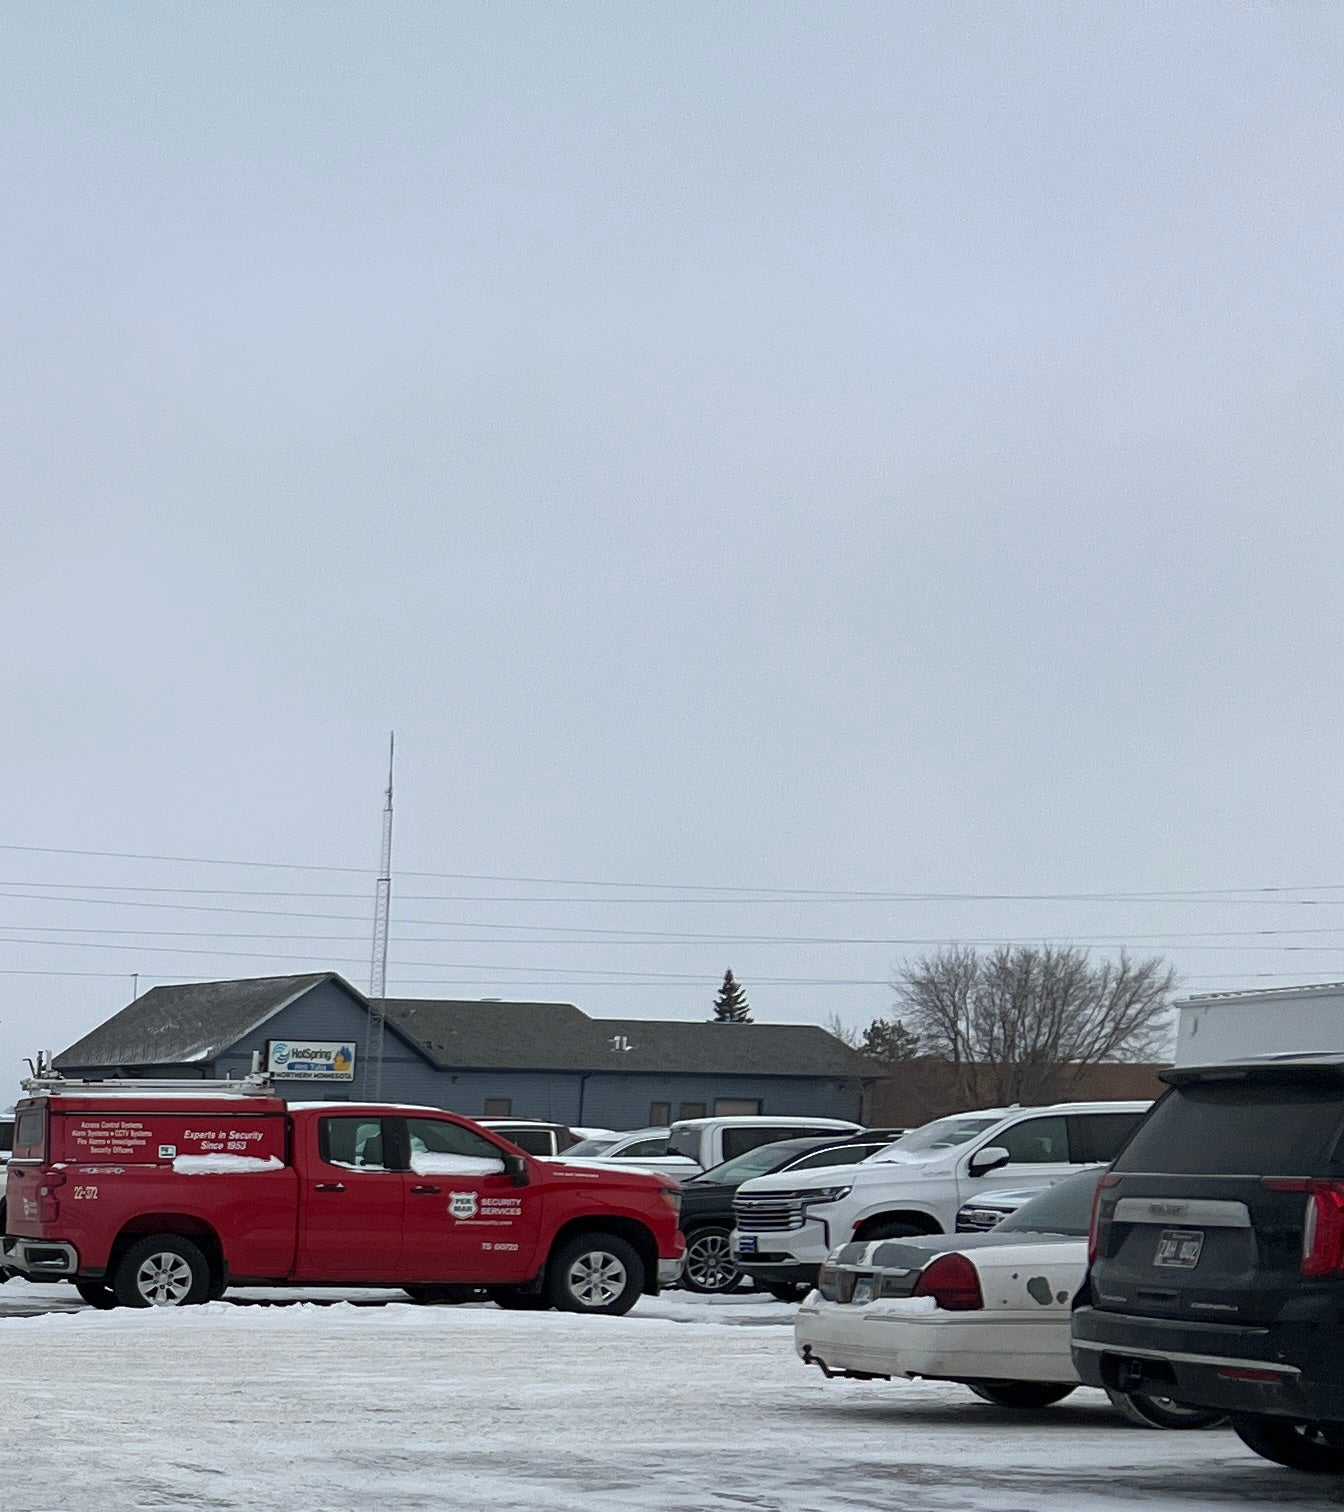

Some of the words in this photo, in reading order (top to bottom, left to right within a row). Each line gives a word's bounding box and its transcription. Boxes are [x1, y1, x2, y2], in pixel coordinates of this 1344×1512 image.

[292, 1048, 332, 1061] HotSpring
[184, 1130, 216, 1140] Experts
[218, 1130, 226, 1139] in
[229, 1131, 263, 1141] Security
[200, 1141, 224, 1150] Since
[91, 1146, 111, 1154] Security
[481, 1198, 521, 1206] SECURITY
[481, 1207, 522, 1215] SERVICES
